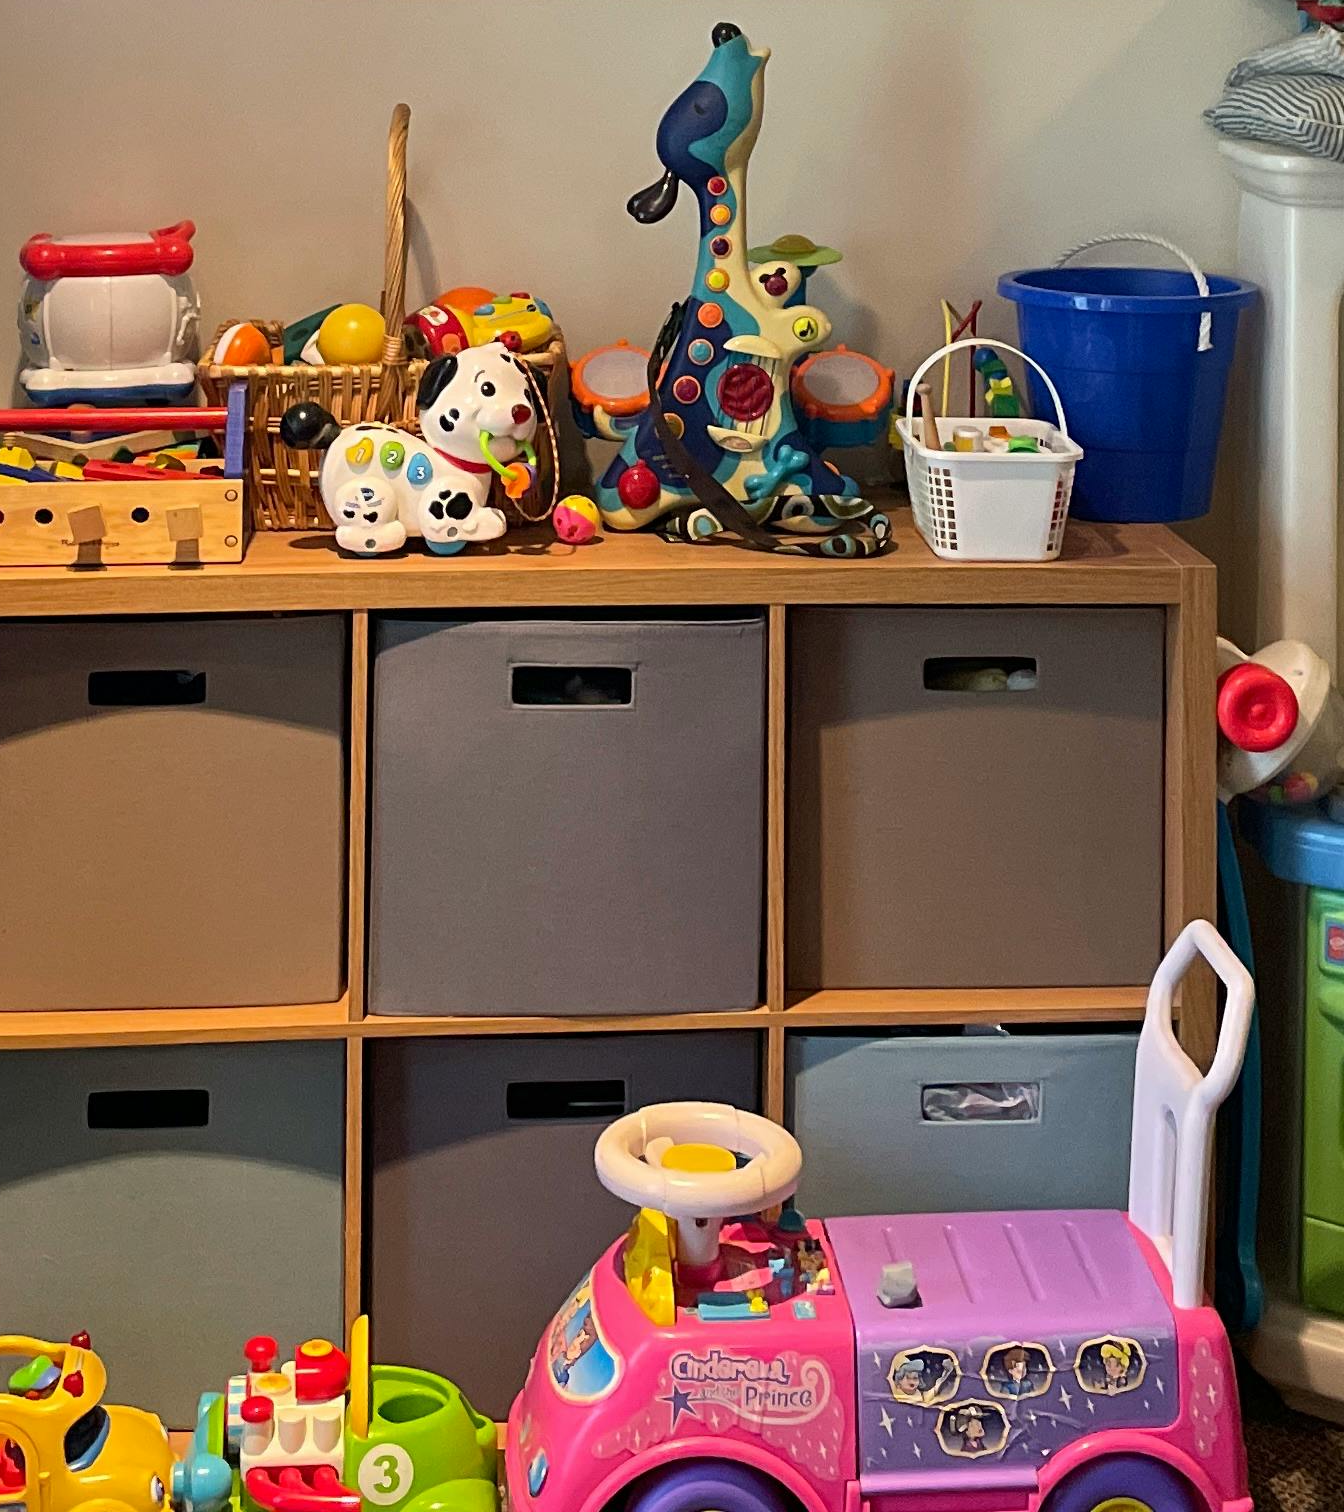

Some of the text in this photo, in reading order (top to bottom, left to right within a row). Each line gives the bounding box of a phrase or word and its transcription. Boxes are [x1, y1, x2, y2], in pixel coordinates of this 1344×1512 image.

[356, 448, 366, 463] 1
[386, 450, 398, 464] 2
[416, 466, 425, 480] 3
[745, 1385, 813, 1407] Prince
[373, 1454, 401, 1494] 3
